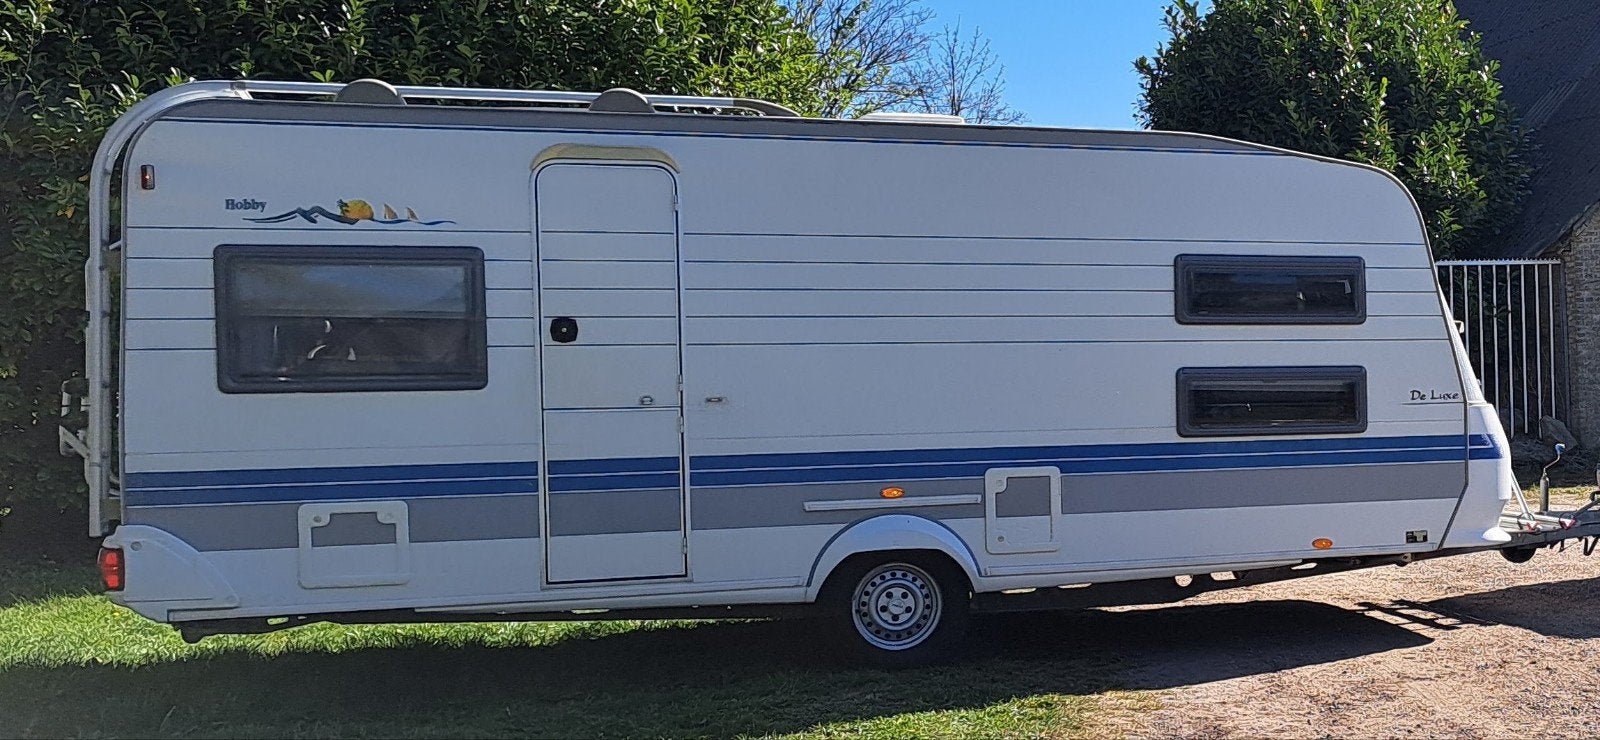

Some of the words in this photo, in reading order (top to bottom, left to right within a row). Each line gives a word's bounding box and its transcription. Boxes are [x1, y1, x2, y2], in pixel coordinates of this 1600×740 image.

[225, 198, 267, 213] Hobby
[1410, 389, 1427, 401] De
[1430, 389, 1460, 401] Luxe
